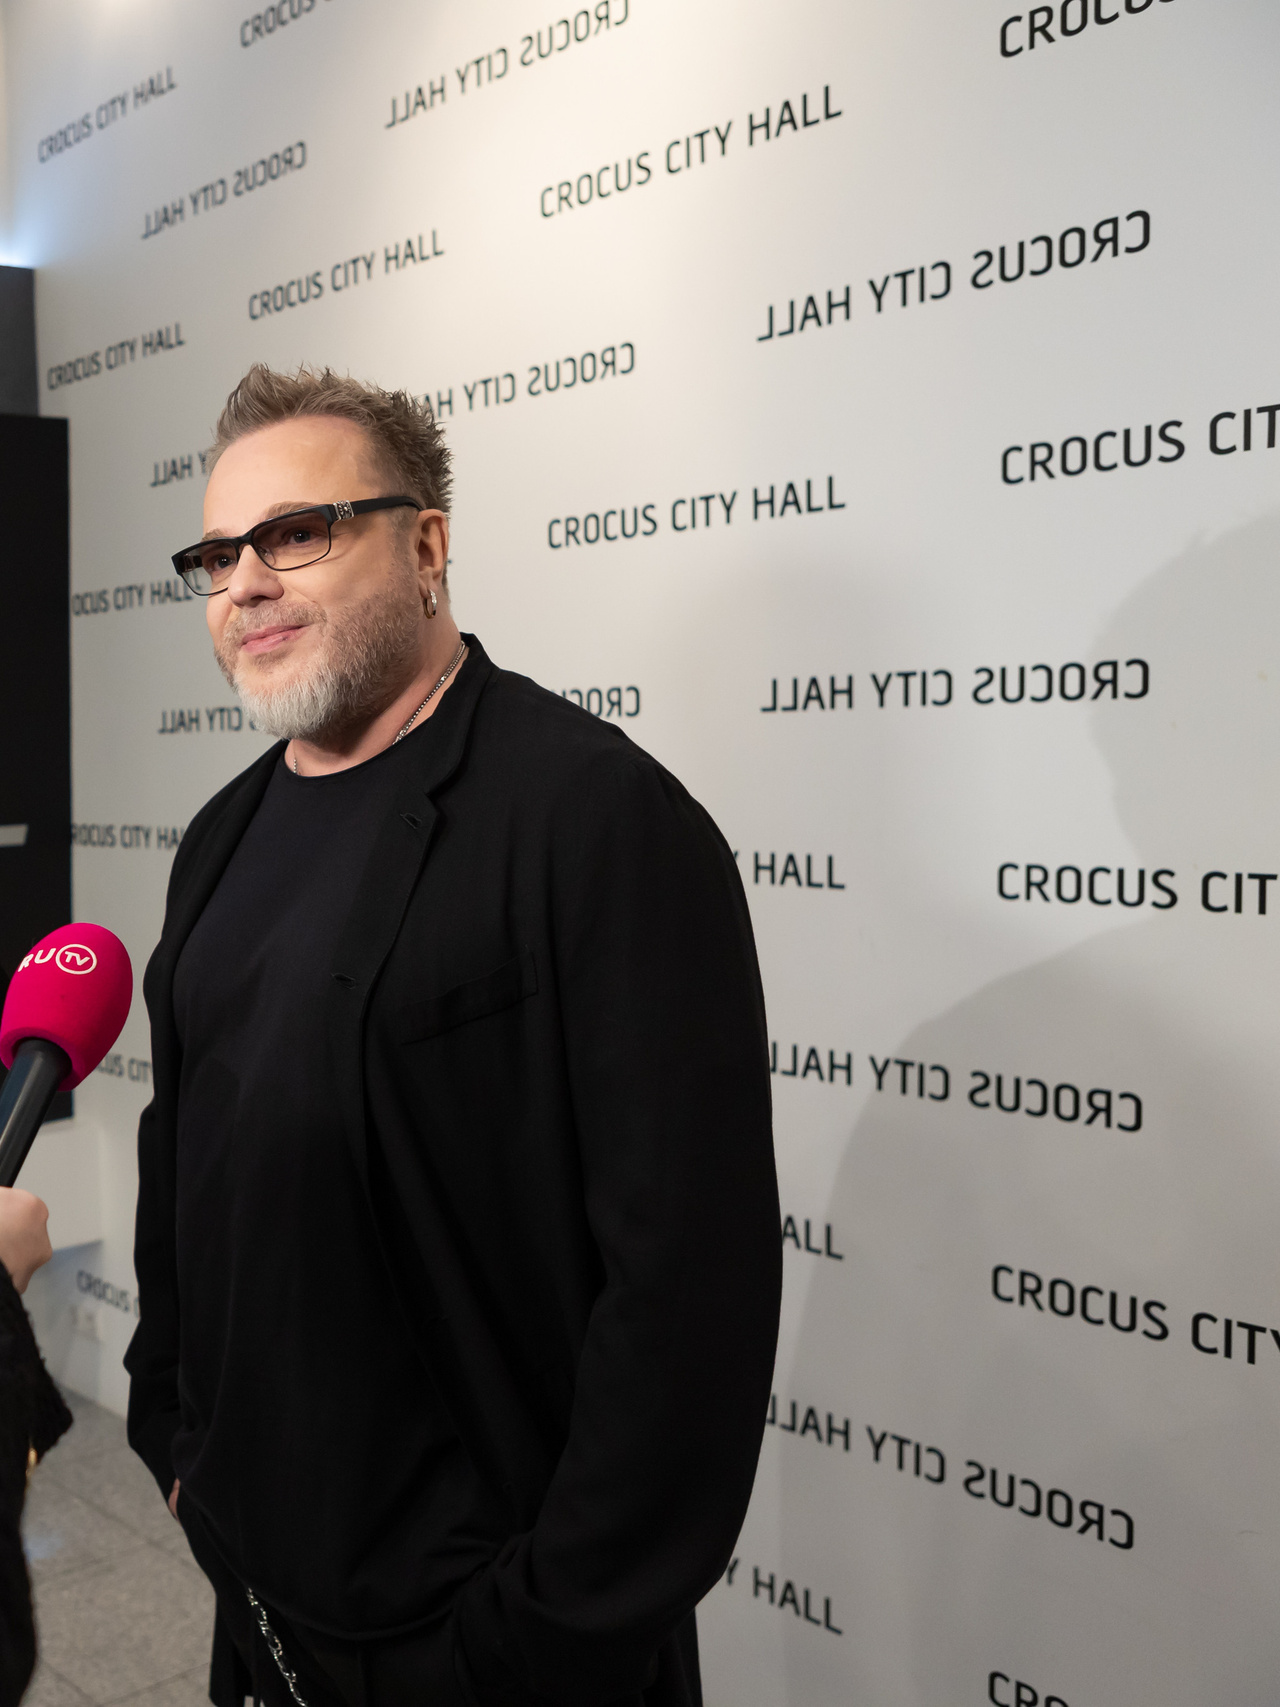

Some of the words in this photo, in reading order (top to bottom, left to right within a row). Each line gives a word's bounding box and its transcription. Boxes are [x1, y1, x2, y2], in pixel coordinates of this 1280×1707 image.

[1000, 0, 1172, 57] CROC
[38, 113, 93, 163] CROCUS
[96, 92, 128, 131] CITY
[133, 66, 177, 110] HALL
[540, 152, 652, 218] CROCUS
[666, 120, 734, 175] CITY
[748, 85, 843, 147] HALL
[248, 270, 324, 320] CROCUS
[331, 252, 375, 292] CITY
[384, 230, 444, 274] HALL
[47, 351, 101, 390] CROCUS
[106, 338, 138, 370] CITY
[142, 323, 185, 357] HALL
[1001, 421, 1185, 485] CROCUS
[1209, 403, 1280, 456] CIT
[548, 505, 658, 549] CROCUS
[671, 491, 737, 532] CITY
[753, 476, 845, 521] HALL
[72, 588, 109, 617] OCUS
[113, 583, 145, 611] CITY
[150, 578, 193, 605] HALL
[121, 824, 150, 849] CITY
[157, 826, 185, 850] HA
[754, 851, 846, 890] HALL
[998, 862, 1178, 910] CROCUS
[1201, 870, 1279, 916] CIT
[18, 947, 57, 972] RU
[64, 950, 91, 966] TV
[128, 1057, 152, 1083] CIT
[781, 1214, 844, 1260] ALL
[992, 1264, 1170, 1342] CROCUS
[752, 1566, 843, 1636] HALL
